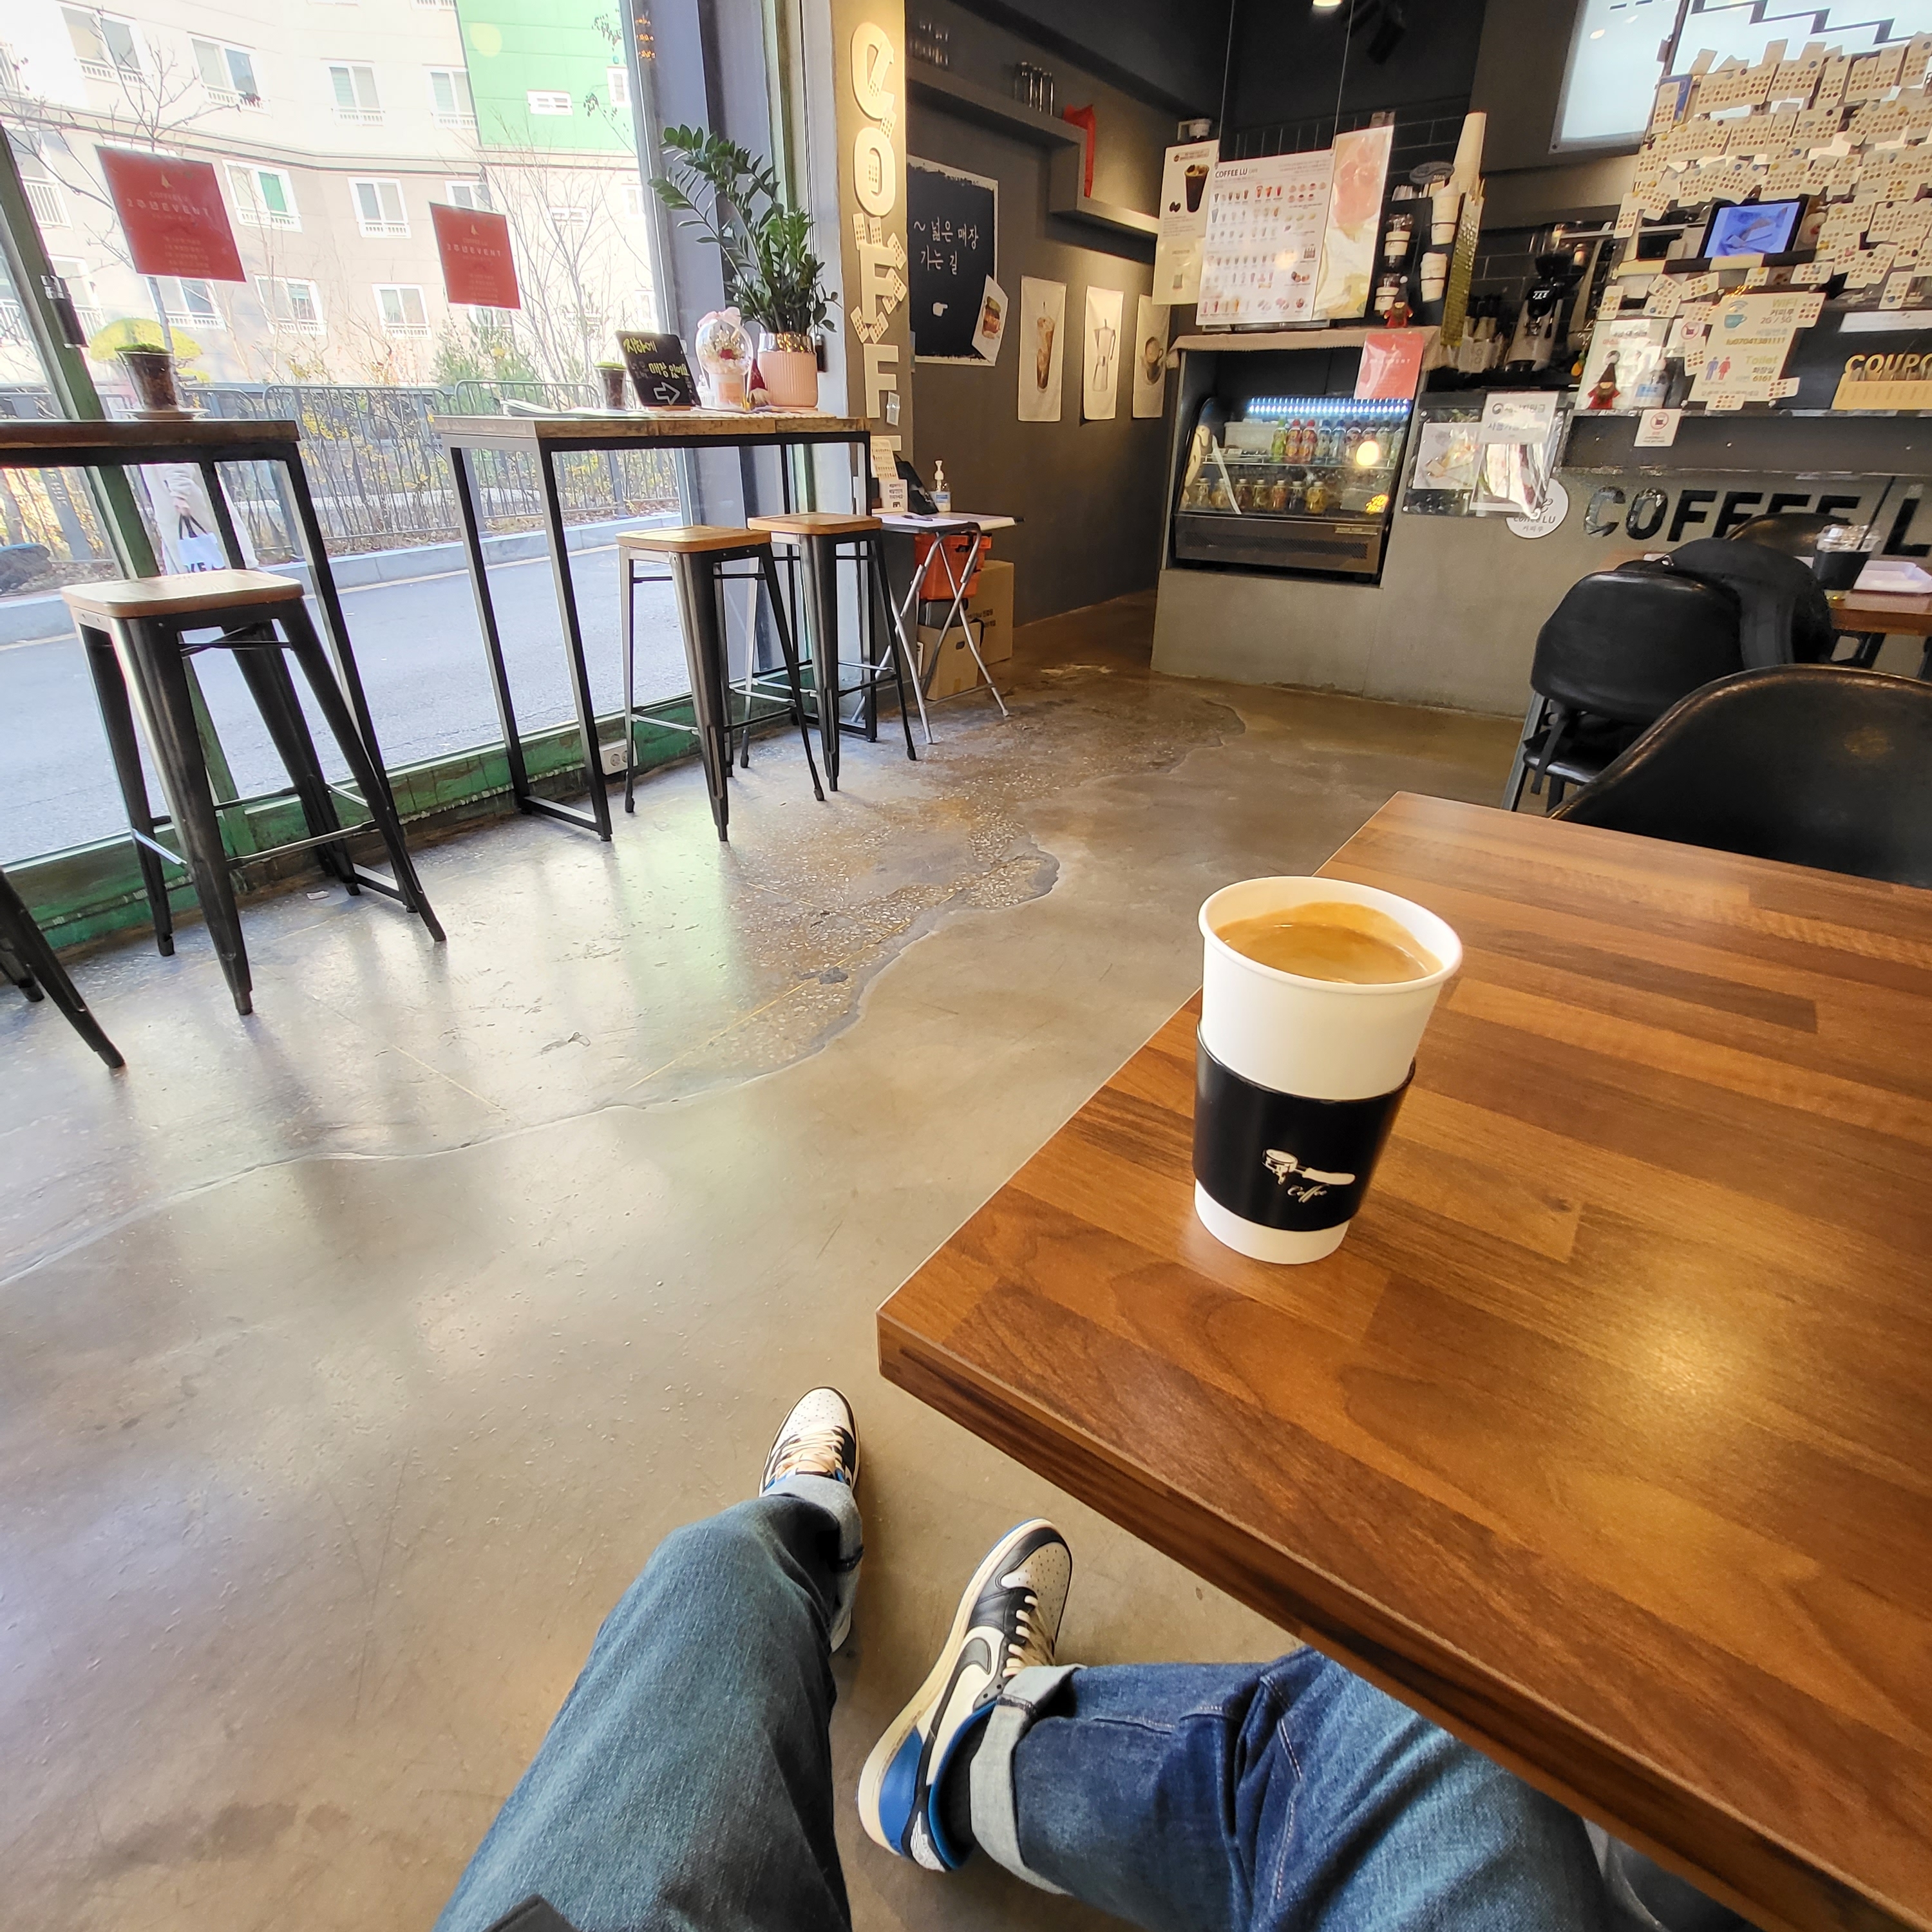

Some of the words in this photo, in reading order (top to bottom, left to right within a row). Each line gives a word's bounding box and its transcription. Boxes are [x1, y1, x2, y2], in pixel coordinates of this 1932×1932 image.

[1215, 169, 1238, 178] COFFEE
[1239, 167, 1248, 176] LU
[931, 216, 954, 242] 넓은
[957, 223, 979, 250] 매장
[920, 245, 944, 271] 가는
[949, 250, 958, 276] 길
[1772, 298, 1798, 307] WIFI
[623, 337, 658, 354] 지하에
[1745, 355, 1779, 365] Toilet
[648, 362, 668, 378] 매장
[668, 363, 691, 379] 있어요
[1542, 515, 1556, 524] LU
